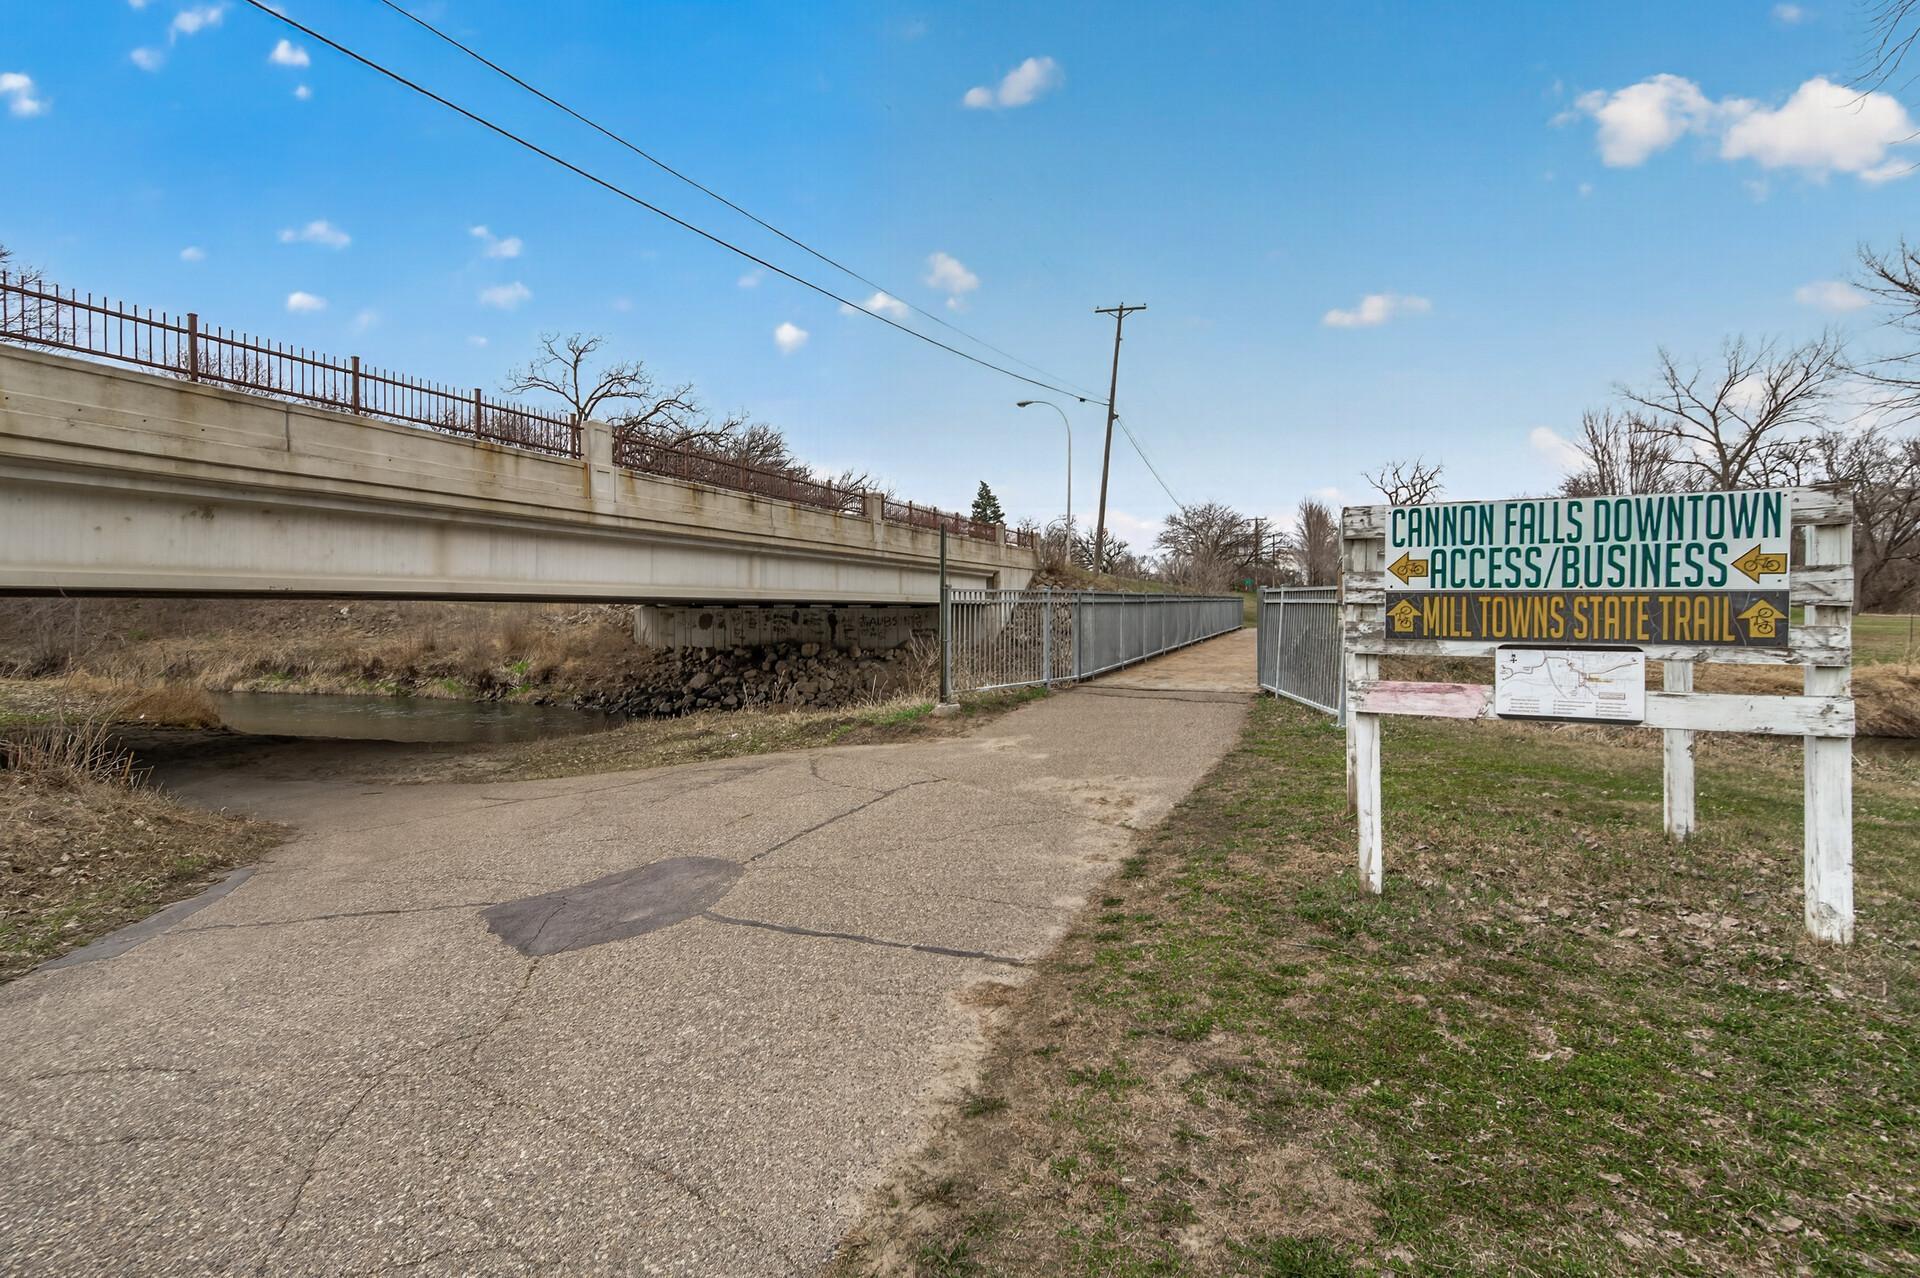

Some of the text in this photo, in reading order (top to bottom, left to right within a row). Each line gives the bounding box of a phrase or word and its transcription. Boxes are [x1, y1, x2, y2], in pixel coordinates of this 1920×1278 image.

[1392, 492, 1781, 547] CANNON FALLS DOWNTOWN
[1431, 542, 1728, 588] ACCESS/BUSINESS
[1423, 596, 1735, 641] MILL TOWNS STATE TRAIL
